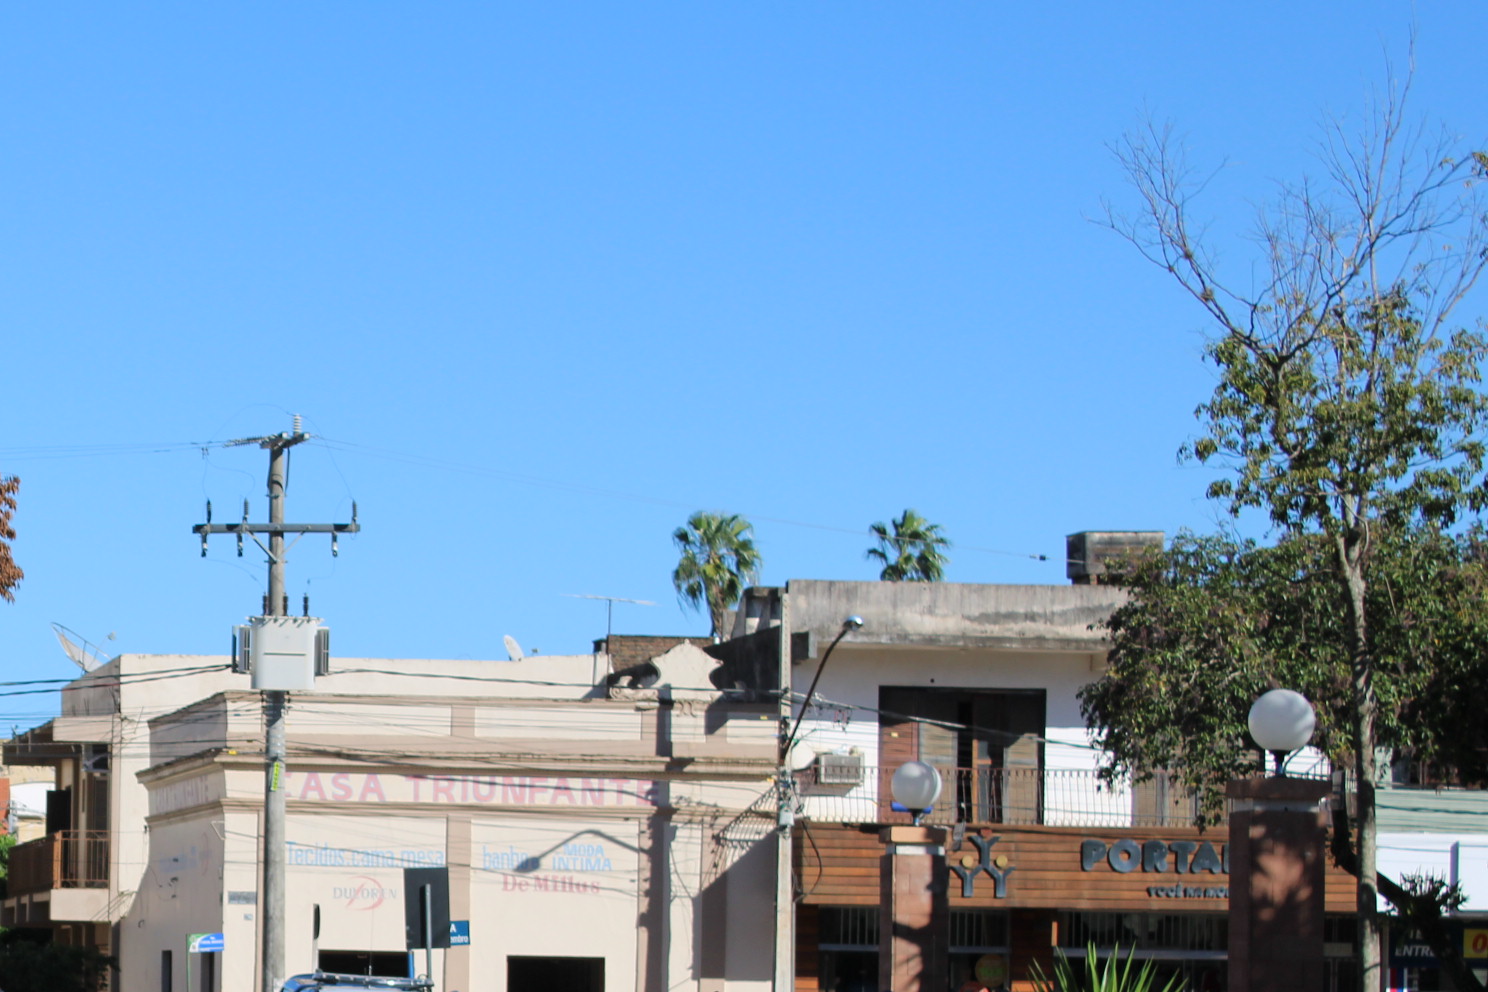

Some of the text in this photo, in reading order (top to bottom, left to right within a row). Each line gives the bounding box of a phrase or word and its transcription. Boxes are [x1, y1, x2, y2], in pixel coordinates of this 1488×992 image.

[284, 773, 386, 802] ASA
[407, 775, 658, 808] TRIUNFANTE
[564, 844, 605, 857] MODA
